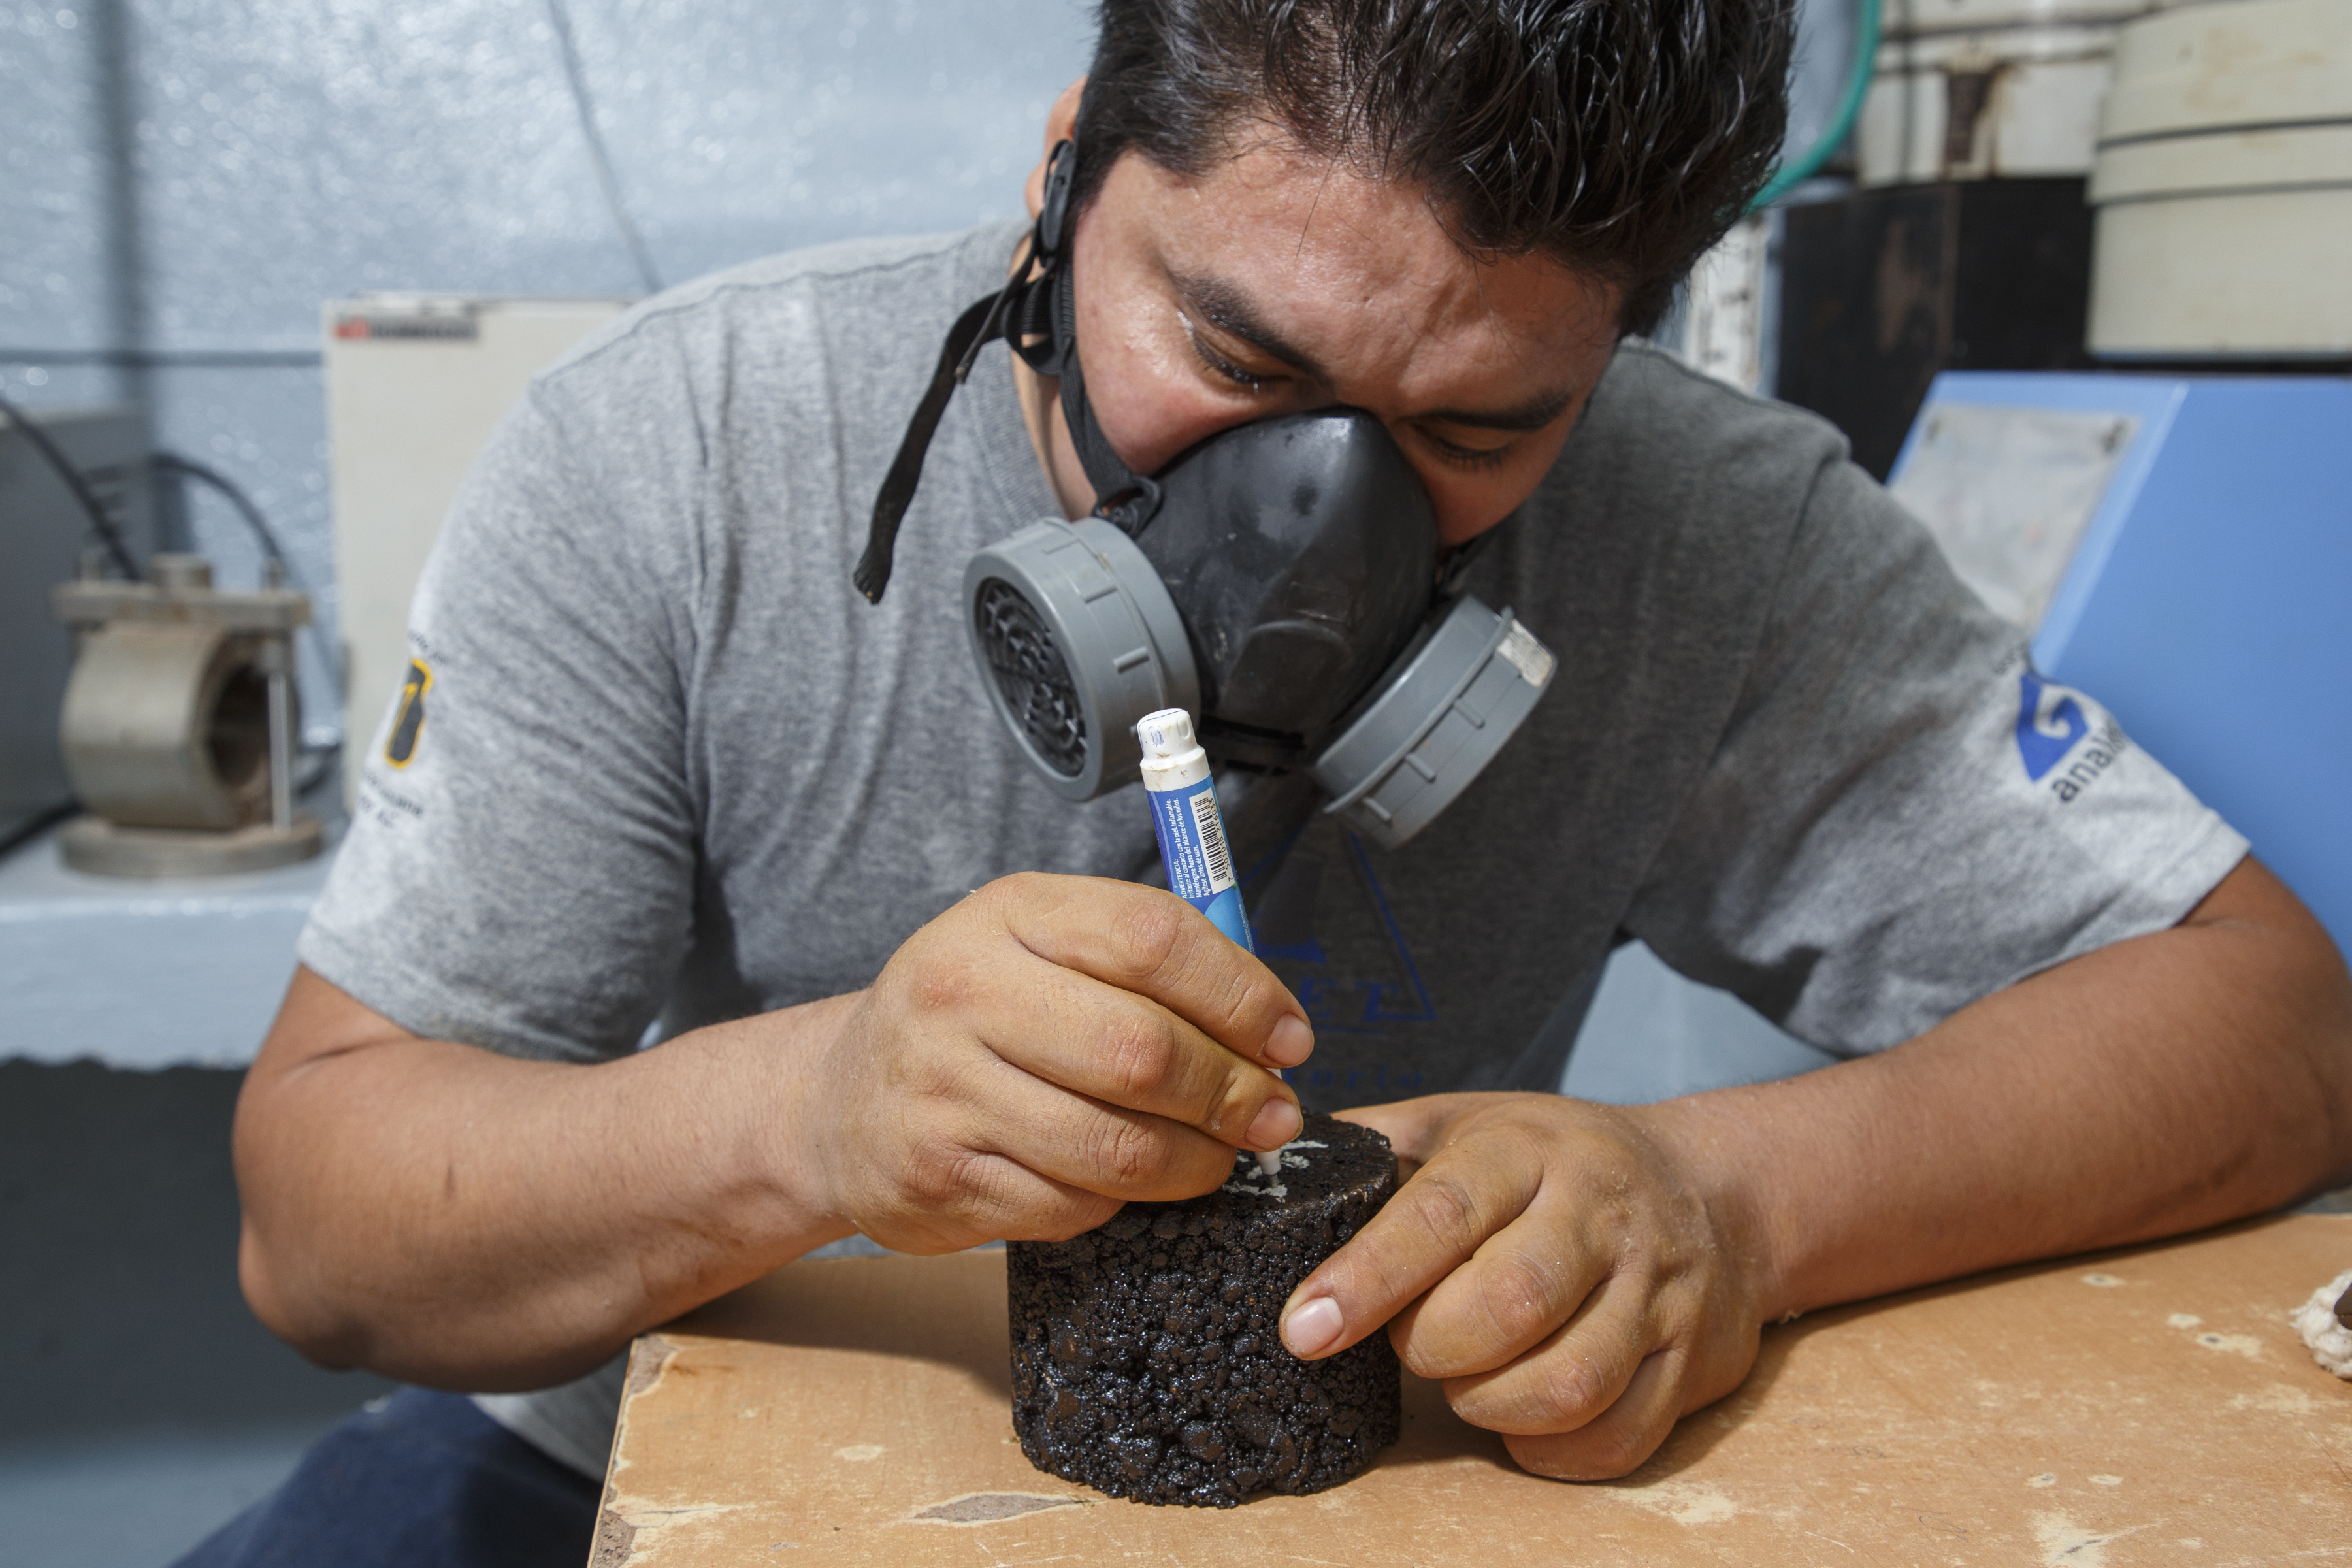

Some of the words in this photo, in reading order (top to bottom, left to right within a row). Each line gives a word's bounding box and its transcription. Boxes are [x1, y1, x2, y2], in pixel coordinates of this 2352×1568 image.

[1166, 799, 1177, 826] Inflamable.
[1209, 798, 1222, 832] 216033
[1171, 826, 1181, 838] piel.
[1181, 828, 1190, 846] alcance
[1183, 846, 1192, 855] del
[1218, 836, 1230, 870] 501015
[1179, 852, 1188, 874] contacto
[1173, 858, 1188, 899] ADVERTENCIA:
[1185, 879, 1195, 899] Irritante
[1190, 868, 1202, 898] Manténgase
